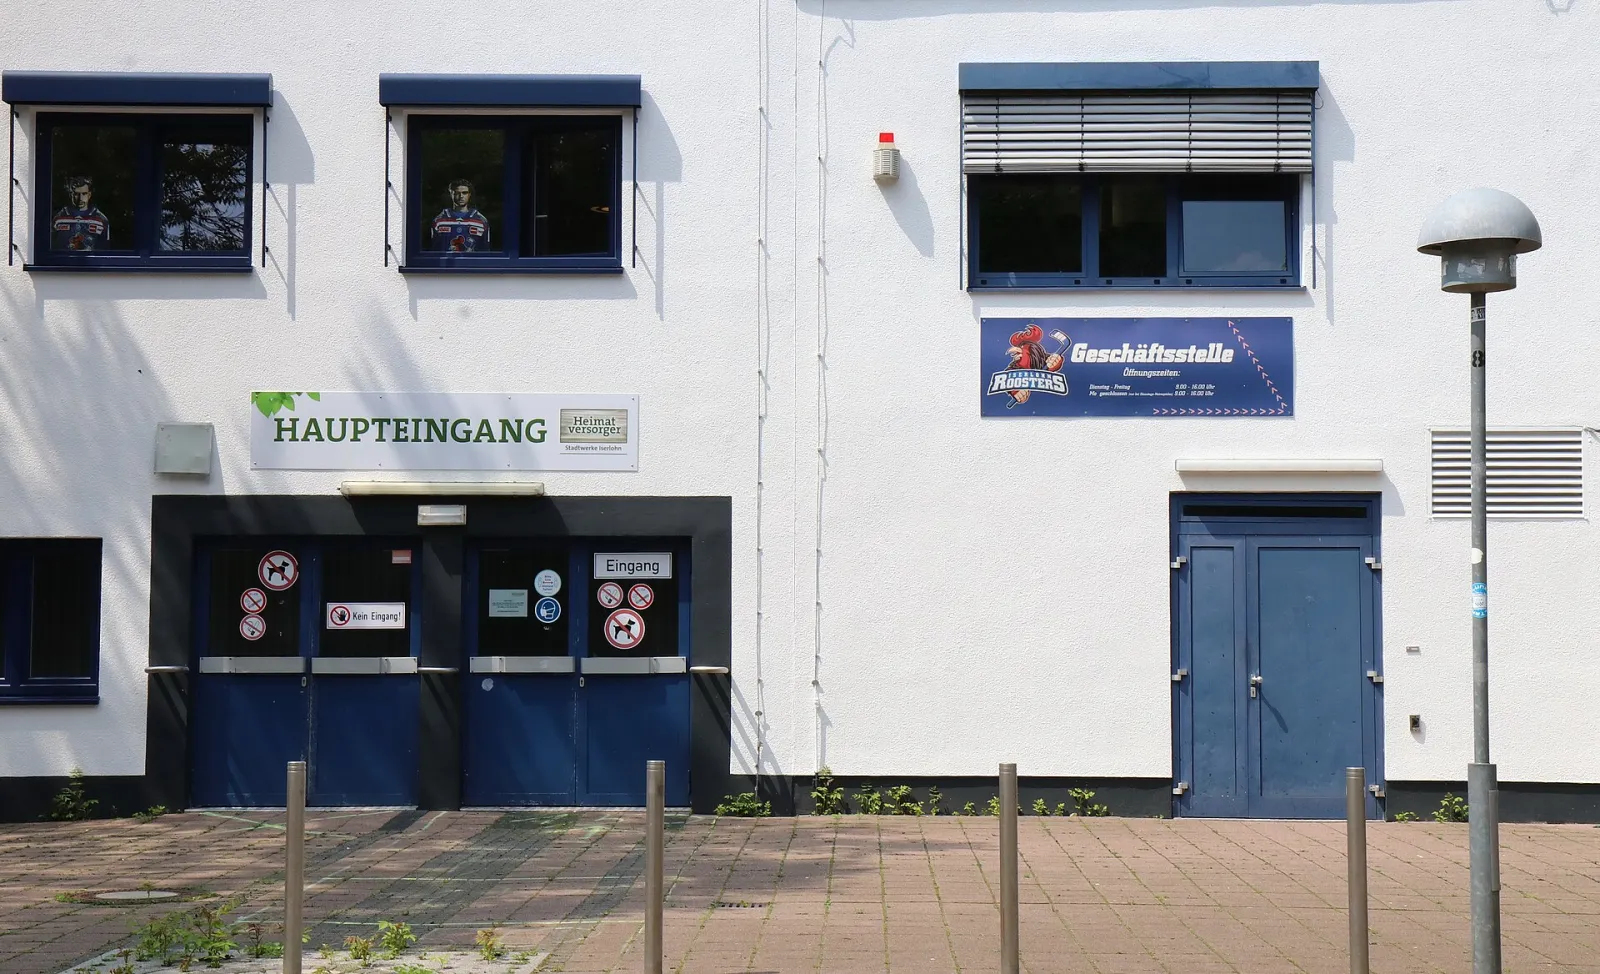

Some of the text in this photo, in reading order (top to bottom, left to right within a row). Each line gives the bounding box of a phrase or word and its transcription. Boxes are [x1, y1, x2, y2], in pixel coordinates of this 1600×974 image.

[1071, 343, 1234, 363] Geschäftsstelle
[1123, 367, 1181, 378] Öffnungszeiten:
[991, 373, 1066, 392] ROOSTERS
[573, 416, 615, 426] Heimat
[273, 418, 547, 443] HAUPTEINGANG
[568, 426, 621, 437] versorger
[606, 559, 660, 575] Eingang
[352, 612, 401, 622] Kein Eingang!
